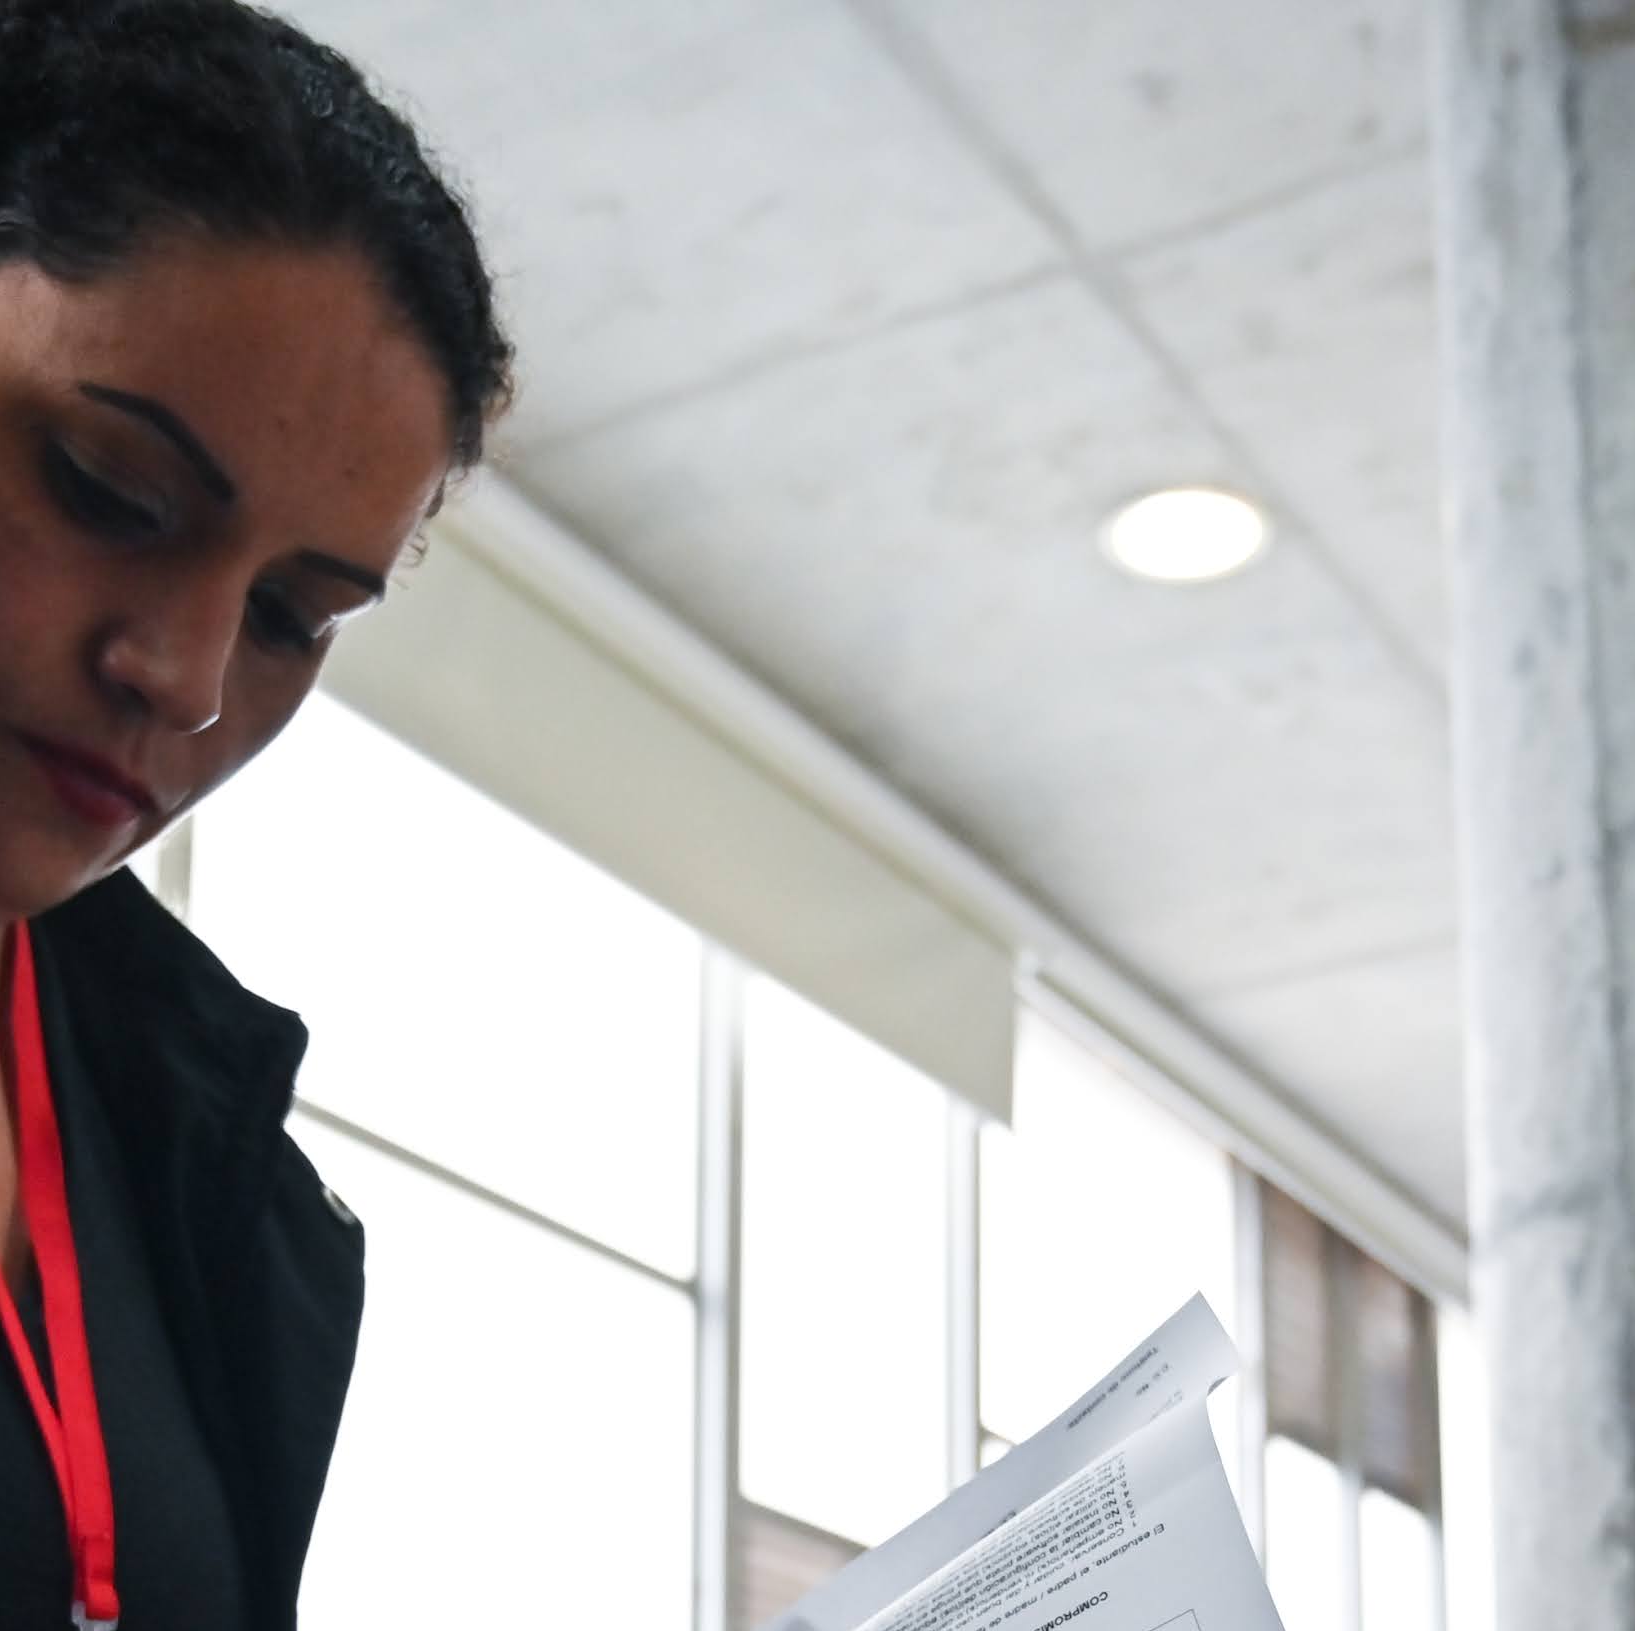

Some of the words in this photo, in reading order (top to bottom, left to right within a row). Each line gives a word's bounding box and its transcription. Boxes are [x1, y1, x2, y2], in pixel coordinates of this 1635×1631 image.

[1102, 1498, 1117, 1509] No
[1104, 1507, 1120, 1520] No
[1107, 1518, 1123, 1530] No
[1153, 1523, 1165, 1535] El
[1046, 1572, 1077, 1594] padre
[1004, 1596, 1038, 1619] madre
[989, 1617, 1002, 1628] de
